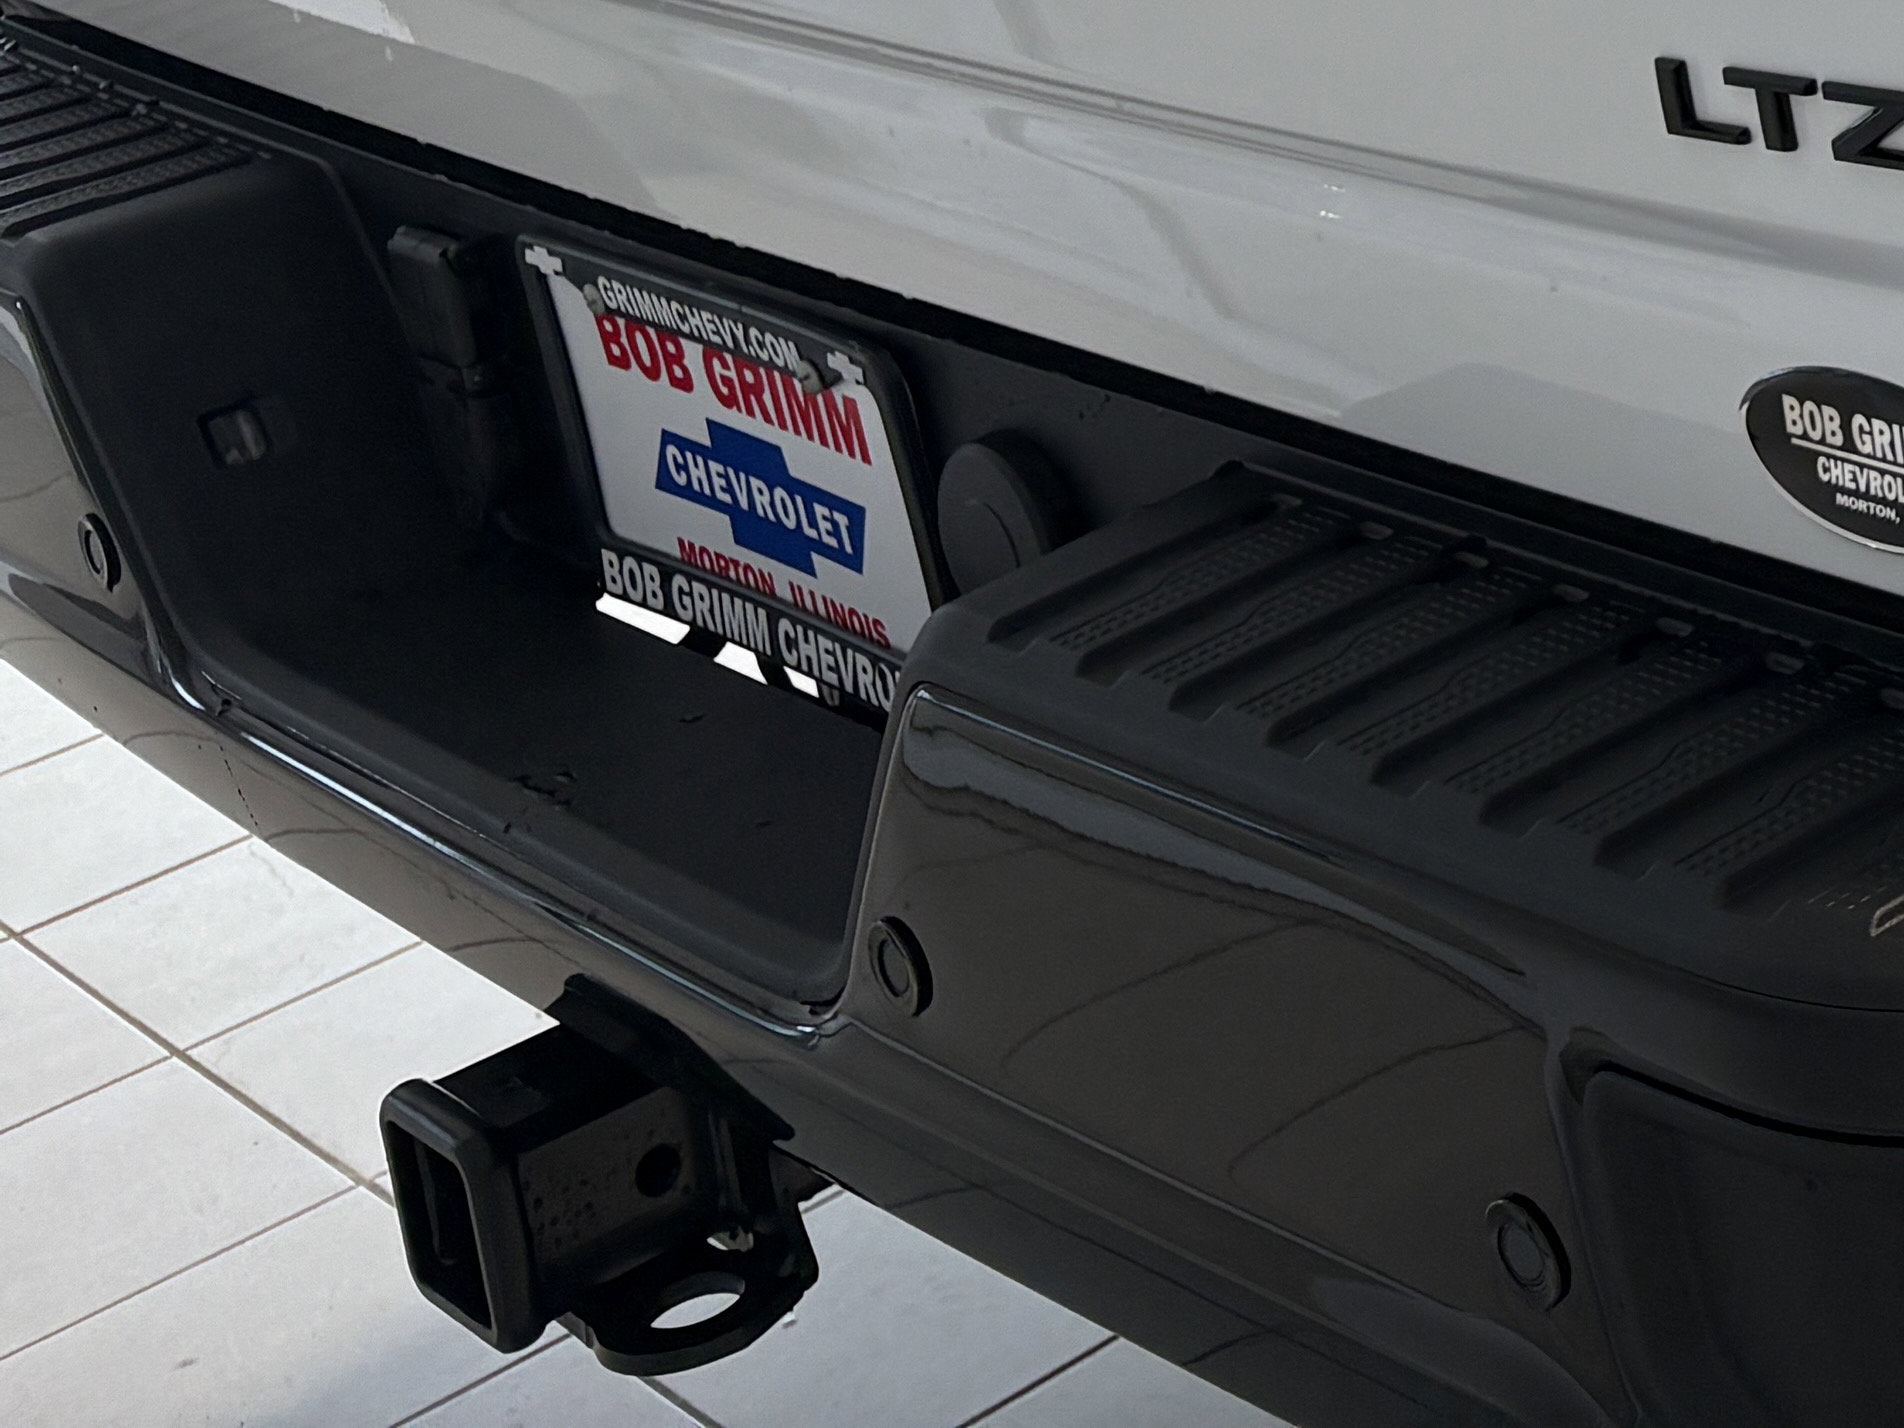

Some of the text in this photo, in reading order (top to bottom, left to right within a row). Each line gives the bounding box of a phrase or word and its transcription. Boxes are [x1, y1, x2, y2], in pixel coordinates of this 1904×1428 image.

[597, 275, 801, 374] GRIMMCHEVY.COM
[595, 314, 873, 466] BOB GRIMM
[1782, 394, 1844, 447] BOB
[665, 443, 854, 555] CHEVROLET
[1836, 492, 1900, 524] MORTON,
[601, 548, 900, 713] BOB GRIMM CHEVRO
[788, 580, 891, 649] ILLINOIS
